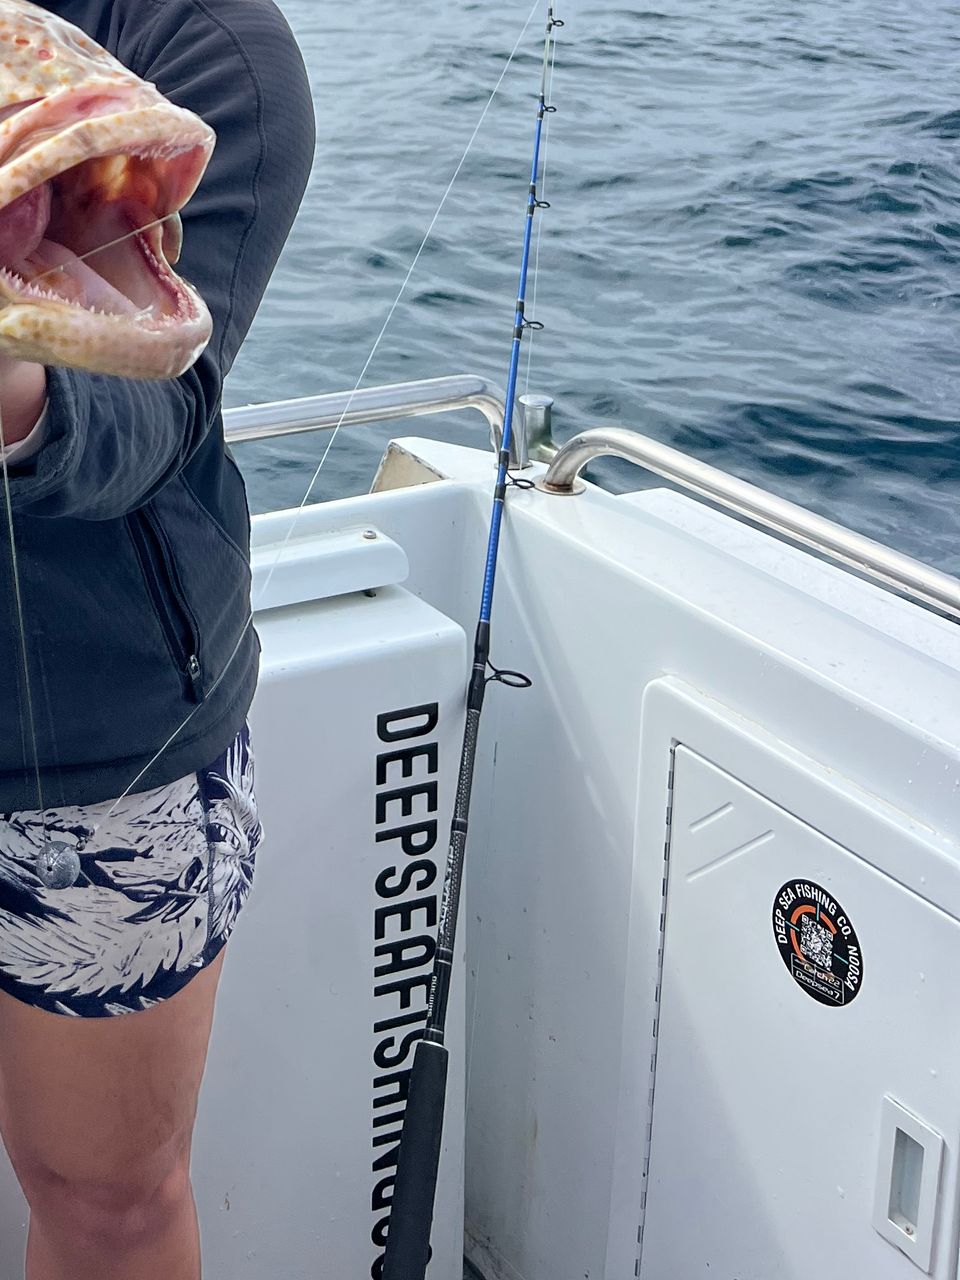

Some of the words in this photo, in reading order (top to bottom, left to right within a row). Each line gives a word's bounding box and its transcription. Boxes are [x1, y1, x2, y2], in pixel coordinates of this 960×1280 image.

[779, 887, 796, 910] SEA
[795, 883, 837, 916] FISHING
[775, 909, 788, 944] DEEP
[836, 915, 852, 940] CO.
[844, 945, 860, 992] NOOSA
